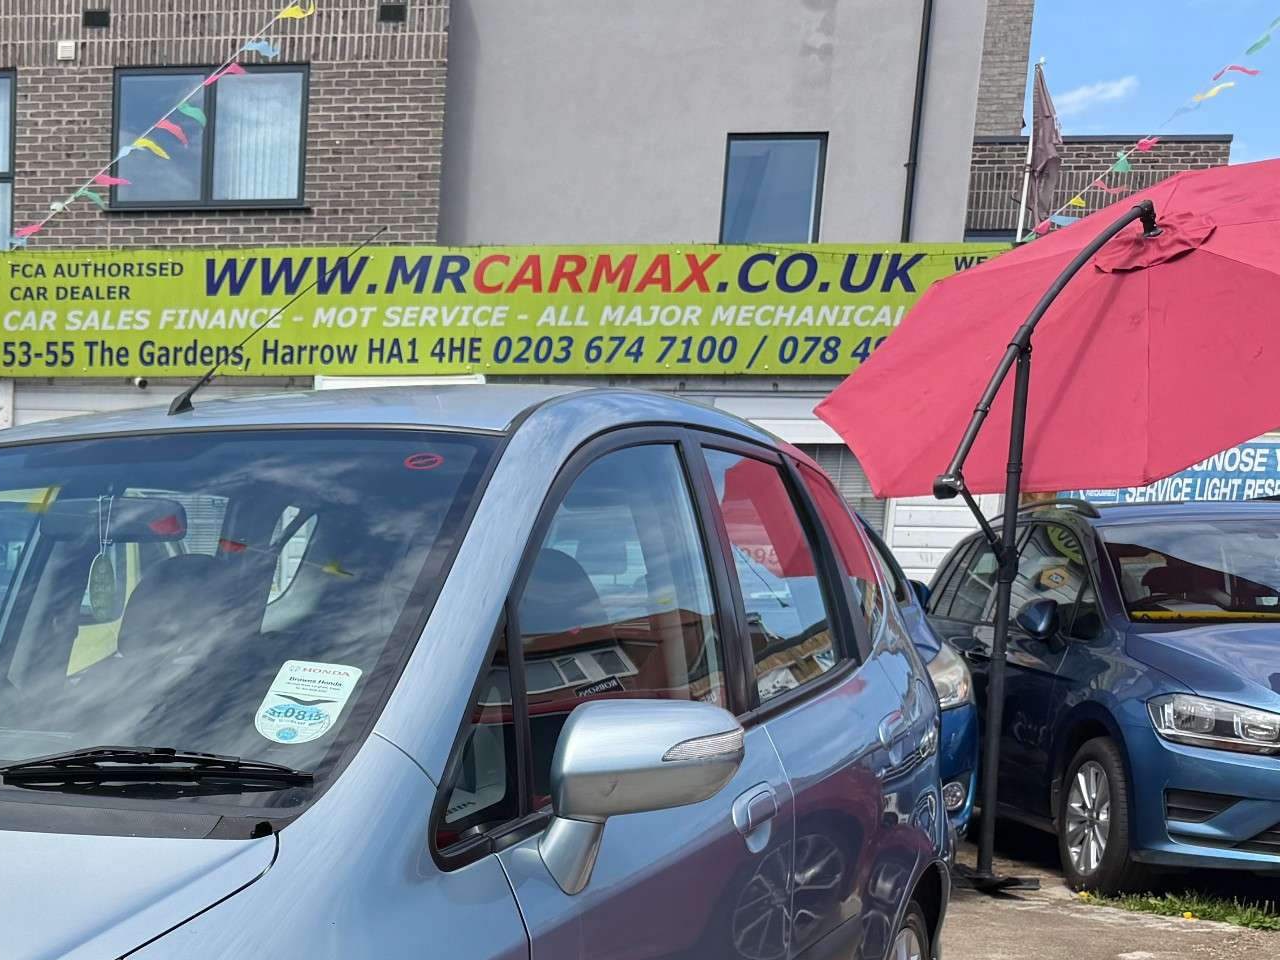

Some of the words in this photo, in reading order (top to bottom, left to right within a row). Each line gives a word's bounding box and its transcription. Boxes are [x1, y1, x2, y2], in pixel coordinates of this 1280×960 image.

[10, 264, 45, 279] FCA
[53, 262, 184, 278] AUTHORISED
[205, 252, 928, 297] WWW.MRCARMAX.CO.UK
[10, 287, 52, 301] CAR
[56, 285, 131, 300] DEALER
[3, 310, 57, 332] CAR
[64, 309, 151, 332] SALES
[159, 307, 283, 331] FINANCE
[313, 307, 377, 329] MOT
[383, 304, 508, 329] SERVICE
[536, 305, 589, 327] ALL
[599, 304, 701, 328] MAJOR
[3, 341, 75, 367] 53-55
[84, 340, 130, 367] The
[139, 338, 251, 371] Gardens,
[262, 338, 358, 366] Harrow
[367, 337, 419, 364] HA1
[430, 336, 481, 364] 4HE
[493, 336, 573, 365] 0203
[584, 336, 643, 365] 674
[655, 335, 737, 364] 7100
[778, 336, 840, 365] 078
[1125, 478, 1193, 502] SERVICE
[1195, 479, 1243, 501] LIGHT
[303, 667, 350, 677] HONDA
[318, 679, 342, 687] Honda
[284, 707, 307, 720] 08
